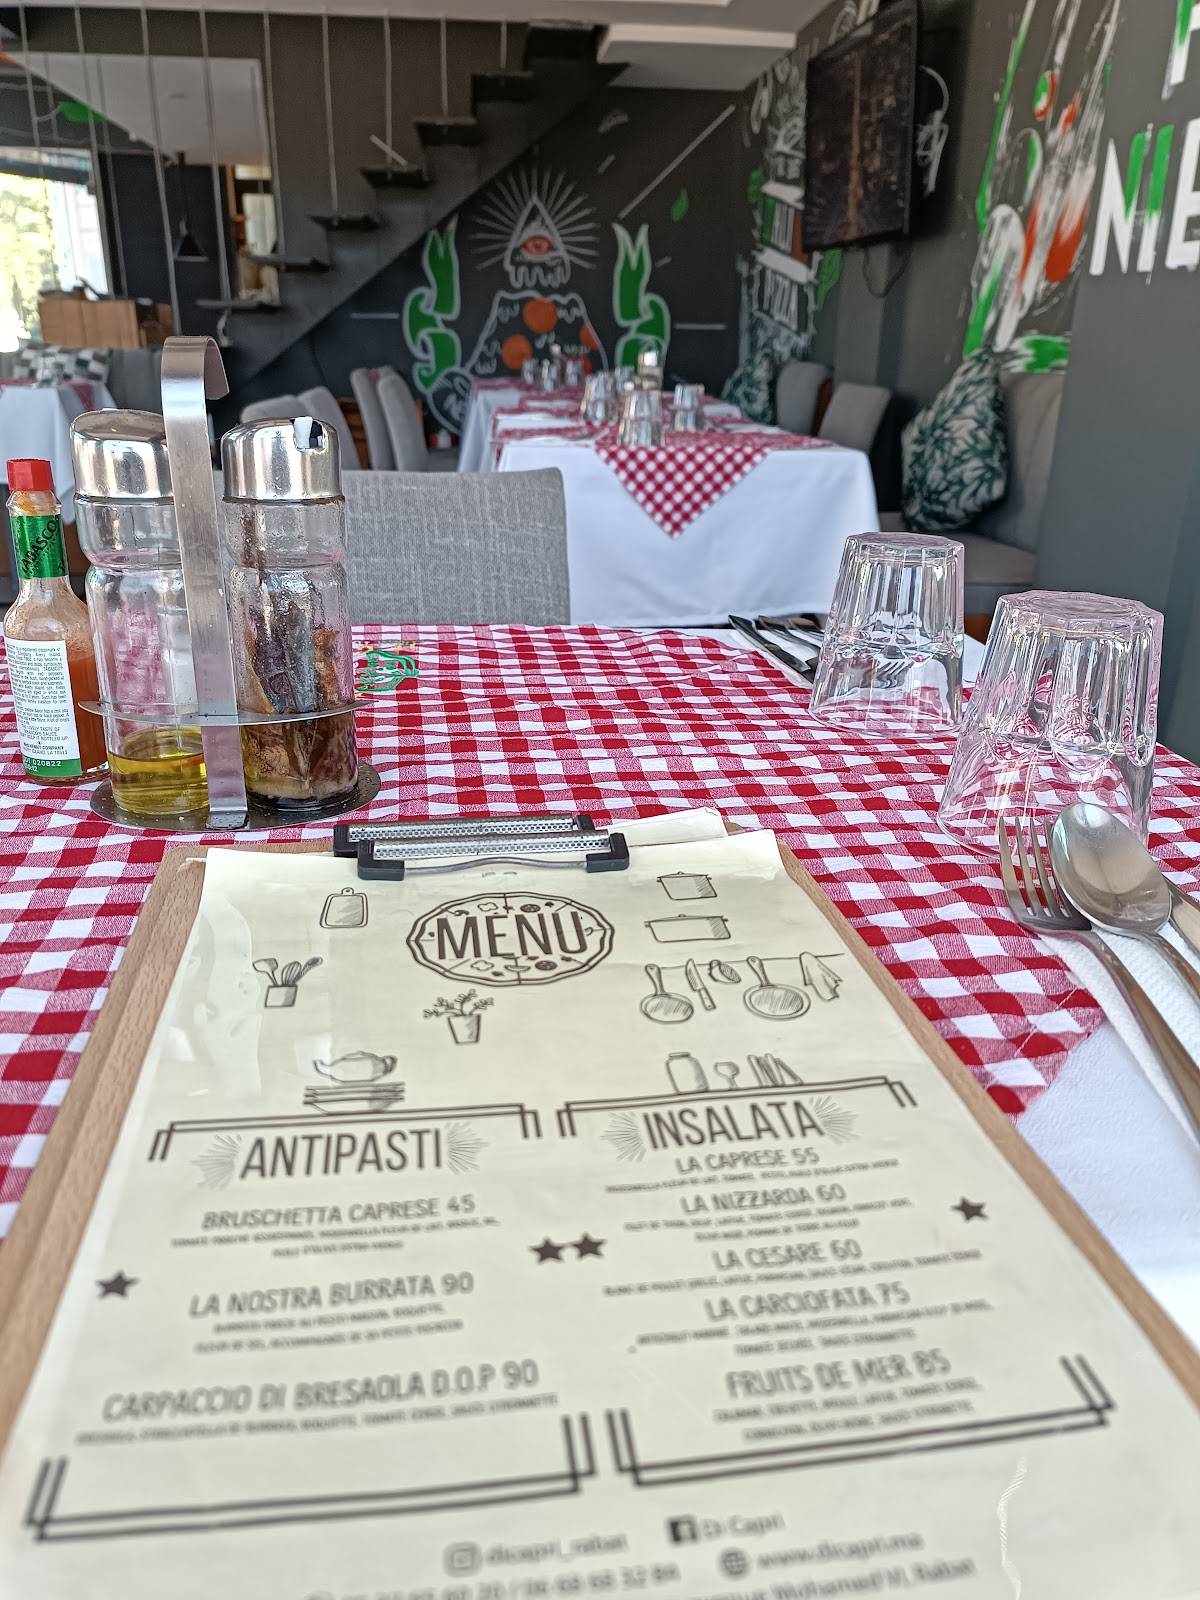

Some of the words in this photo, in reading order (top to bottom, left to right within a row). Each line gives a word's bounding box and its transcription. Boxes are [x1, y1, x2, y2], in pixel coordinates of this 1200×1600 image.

[436, 911, 588, 960] MENU
[643, 1099, 825, 1151] INSALATA
[239, 1127, 443, 1179] ANTIPASTI
[675, 1156, 701, 1174] LA
[704, 1149, 788, 1171] CAPRESE
[791, 1147, 820, 1165] 55
[202, 1206, 343, 1231] BRUSCHETTA
[349, 1198, 440, 1223] CAPRESE
[446, 1194, 477, 1214] 45
[680, 1194, 709, 1215] LA
[712, 1186, 814, 1212] NIZZARDA
[816, 1183, 847, 1202] 60
[712, 1247, 741, 1272] LA
[745, 1240, 828, 1267] CESARE
[830, 1238, 863, 1261] 60
[189, 1293, 220, 1318] LA
[226, 1285, 323, 1315] NOSTRA
[328, 1274, 436, 1308] BURRATA
[440, 1271, 475, 1296] 90
[704, 1298, 738, 1322] LA
[742, 1284, 879, 1318] CARCIOFATA
[876, 1281, 911, 1306] 75
[103, 1384, 252, 1423] CARPACCIO
[259, 1382, 287, 1412] DI
[293, 1371, 426, 1411] BRESAOLA
[502, 1358, 540, 1390] 90
[725, 1364, 814, 1399] FRUITS
[815, 1360, 849, 1388] DE
[852, 1354, 913, 1385] MER
